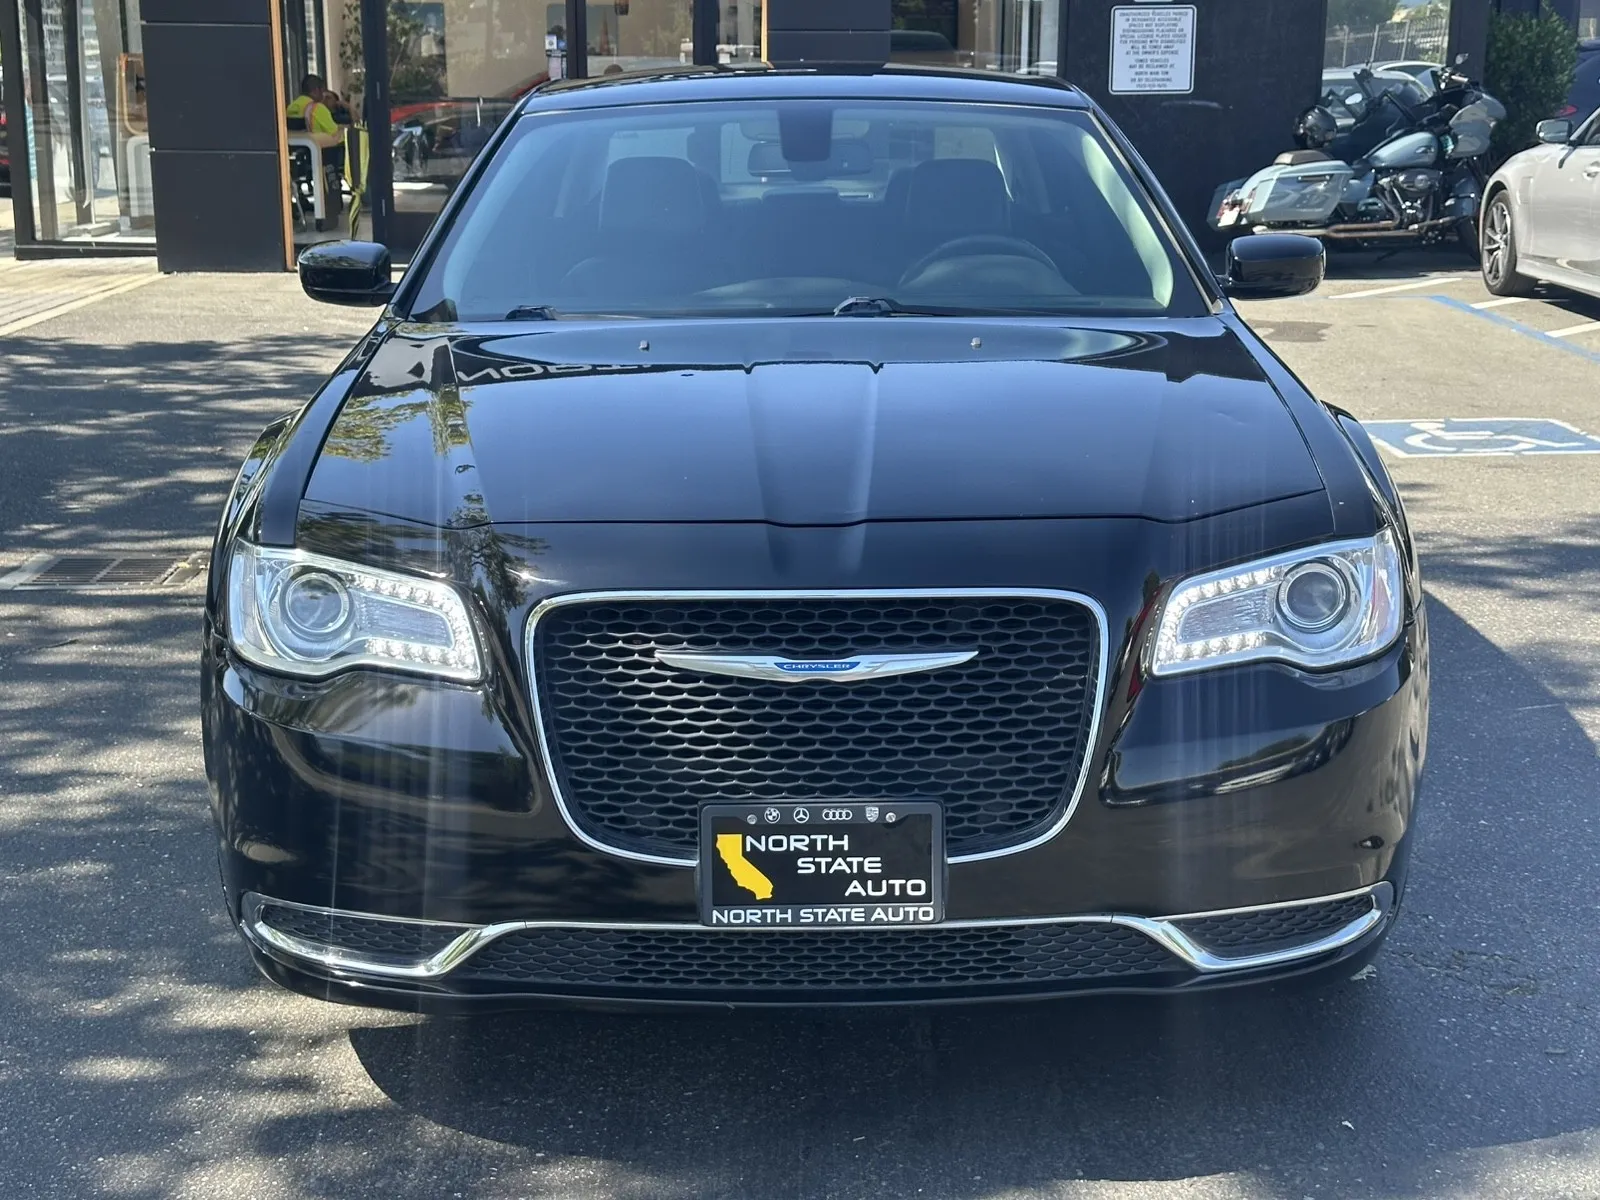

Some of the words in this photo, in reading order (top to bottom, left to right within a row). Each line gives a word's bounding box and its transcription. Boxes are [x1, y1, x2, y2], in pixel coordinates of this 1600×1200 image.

[745, 834, 849, 852] NORTH
[797, 856, 882, 874] STATE
[844, 879, 926, 897] AUTO
[712, 908, 792, 924] NORTH
[799, 907, 865, 923] STATE
[870, 906, 934, 922] AUTO
